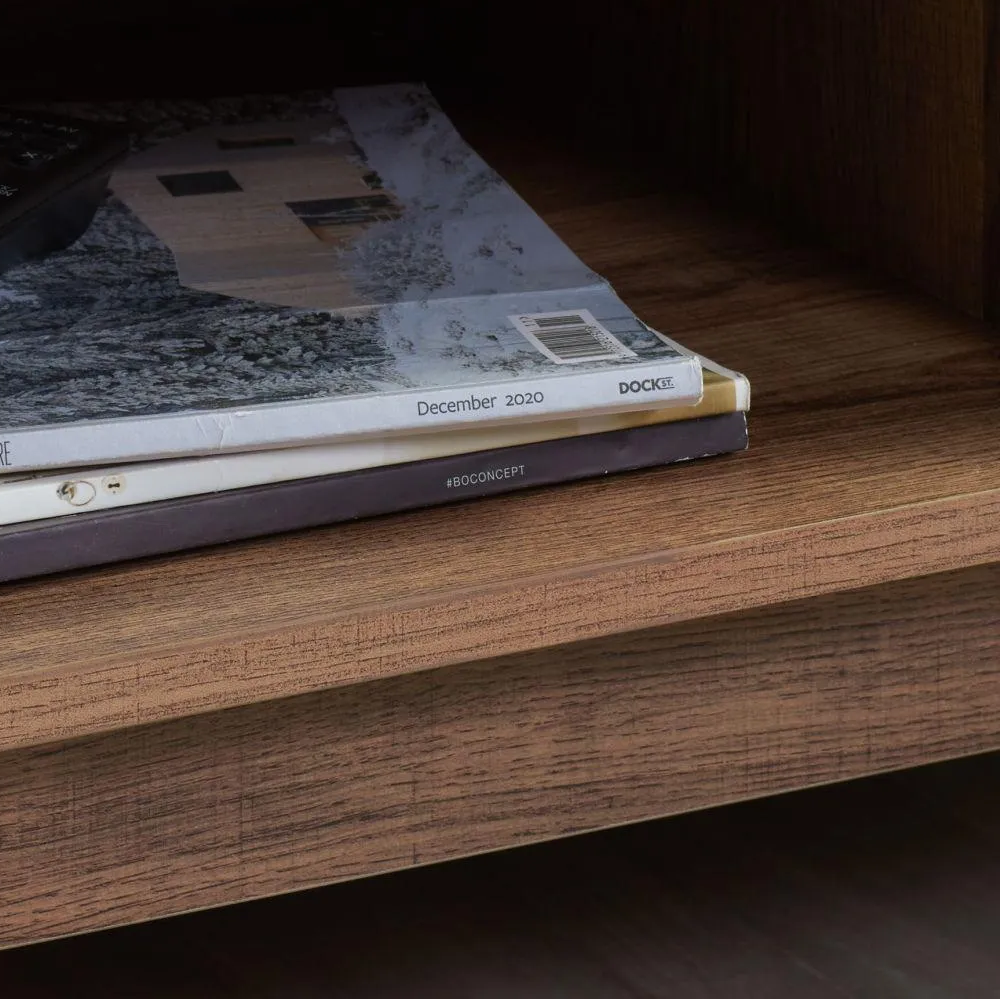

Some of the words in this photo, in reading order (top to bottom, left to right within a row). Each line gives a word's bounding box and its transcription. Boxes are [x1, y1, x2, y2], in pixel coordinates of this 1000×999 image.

[619, 378, 661, 394] DOCK
[418, 395, 497, 416] December
[505, 391, 544, 407] 2020
[446, 465, 525, 488] #BOCONCEPT
